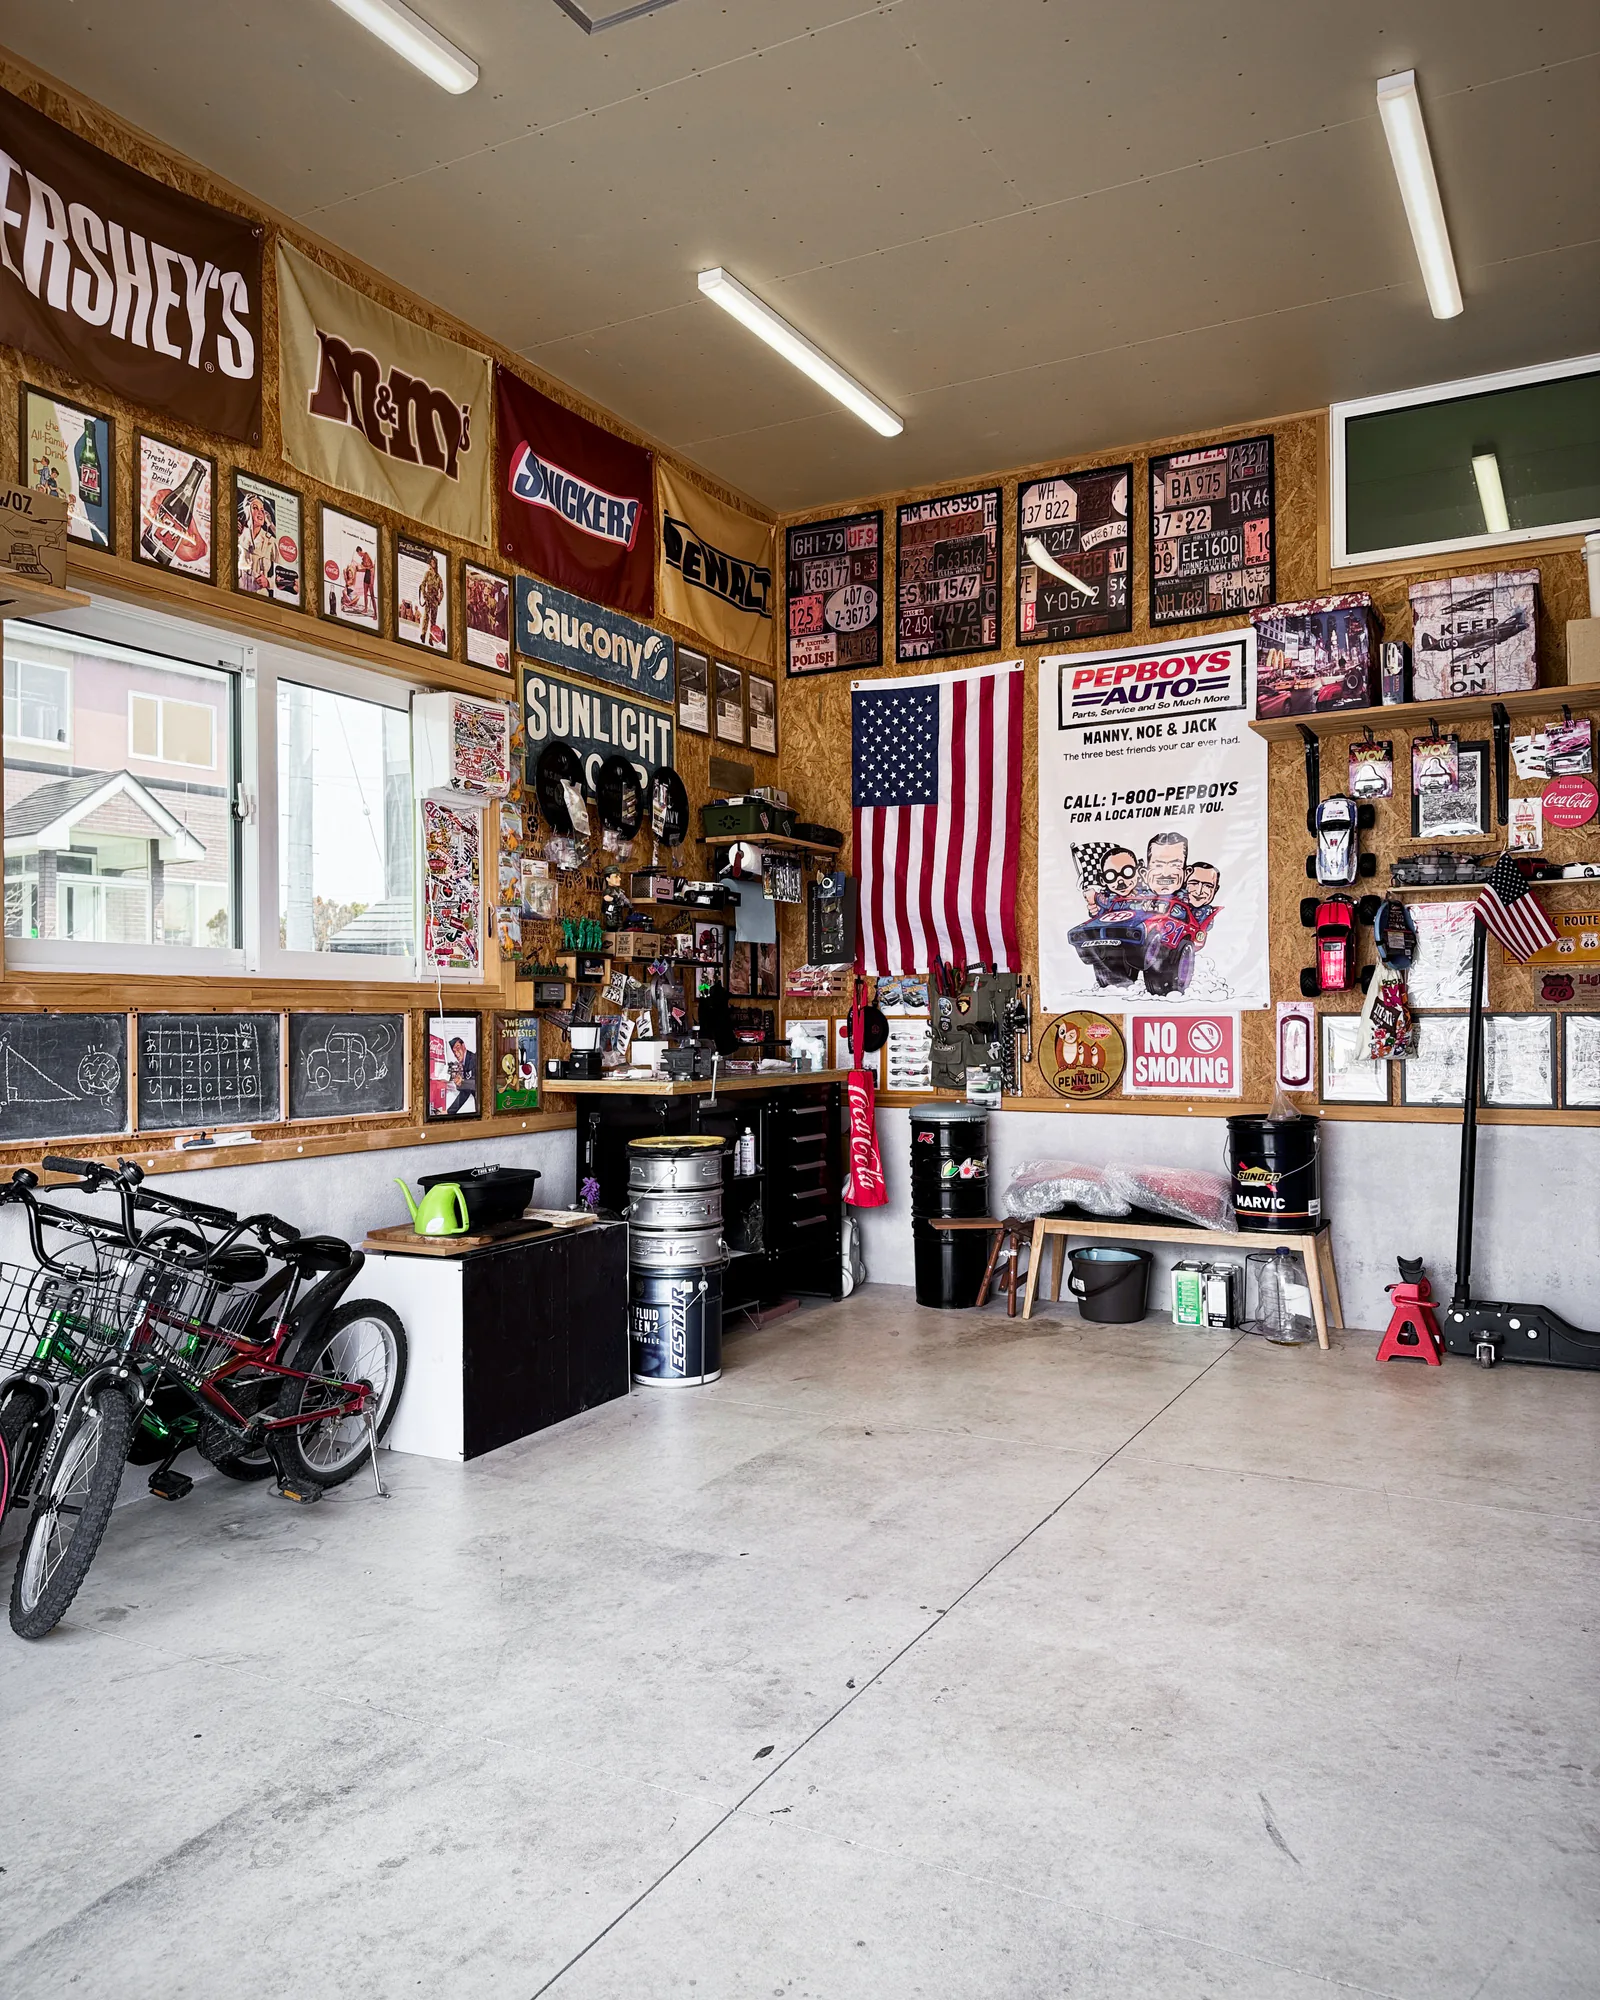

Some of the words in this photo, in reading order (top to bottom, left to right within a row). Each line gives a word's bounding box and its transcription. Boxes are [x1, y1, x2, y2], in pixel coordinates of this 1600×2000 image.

[45, 419, 59, 432] the
[31, 429, 69, 451] All-Family
[45, 446, 67, 462] Drink
[151, 462, 172, 476] Family
[152, 472, 173, 486] Drink!
[1172, 477, 1192, 499] BA
[1196, 473, 1220, 495] 975
[1045, 499, 1069, 520] 822
[1231, 490, 1249, 514] DK
[1193, 531, 1228, 541] HOLLYWOOD
[1182, 556, 1227, 570] CONNECTICUT
[1183, 562, 1239, 576] POTAMKIN
[844, 588, 862, 606] 407
[1110, 594, 1125, 607] 34
[1179, 590, 1202, 611] 789
[791, 607, 814, 627] 125
[936, 602, 977, 626] 7472
[527, 590, 643, 680] Saucony
[792, 651, 835, 668] POLISH
[1072, 650, 1231, 690] PEPBOYS
[1450, 661, 1489, 677] FLY
[1101, 678, 1197, 706] AUTO
[1450, 678, 1487, 693] ON
[1072, 710, 1098, 720] Parts,
[1100, 706, 1135, 716] Service
[1138, 703, 1155, 712] and
[1157, 701, 1170, 709] So
[1173, 698, 1201, 707] Much
[1203, 694, 1230, 703] More
[1137, 724, 1163, 740] NOE
[1167, 722, 1178, 736] &
[1182, 718, 1217, 734] JACK
[1063, 752, 1079, 761] The
[1081, 750, 1103, 760] three
[1106, 748, 1124, 757] best
[1126, 744, 1156, 755] friends
[1158, 743, 1178, 756] your
[1180, 741, 1195, 749] car
[1197, 739, 1218, 748] ever
[1220, 736, 1240, 745] had.
[1355, 750, 1386, 762] WCW
[1418, 744, 1451, 756] WCW
[1063, 794, 1106, 810] CALL:
[1111, 781, 1239, 806] 1-800-PEPBOYS
[1070, 812, 1091, 823] FOR
[1094, 811, 1102, 821] A
[1105, 806, 1161, 821] LOCATION
[1164, 804, 1195, 817] NEAR
[1199, 801, 1224, 815] YOU.
[1101, 911, 1134, 922] PEP
[1564, 916, 1599, 926] ROUTE
[1162, 921, 1184, 945] 21
[1584, 940, 1596, 948] 66
[1548, 987, 1568, 998] 66
[503, 1019, 531, 1027] TWEETY
[502, 1029, 536, 1038] SYLVESTER
[1144, 1021, 1178, 1055] NO
[1136, 1056, 1229, 1085] SMOKING
[225, 1080, 233, 1090] 2
[1058, 1073, 1105, 1088] PENNZOIL
[1238, 1171, 1280, 1182] SUNOCO
[1236, 1194, 1285, 1209] MARVIC
[56, 1221, 116, 1238] KENT
[636, 1307, 659, 1320] FLUID
[652, 1322, 658, 1333] 2
[671, 1286, 686, 1377] ECSTAR
